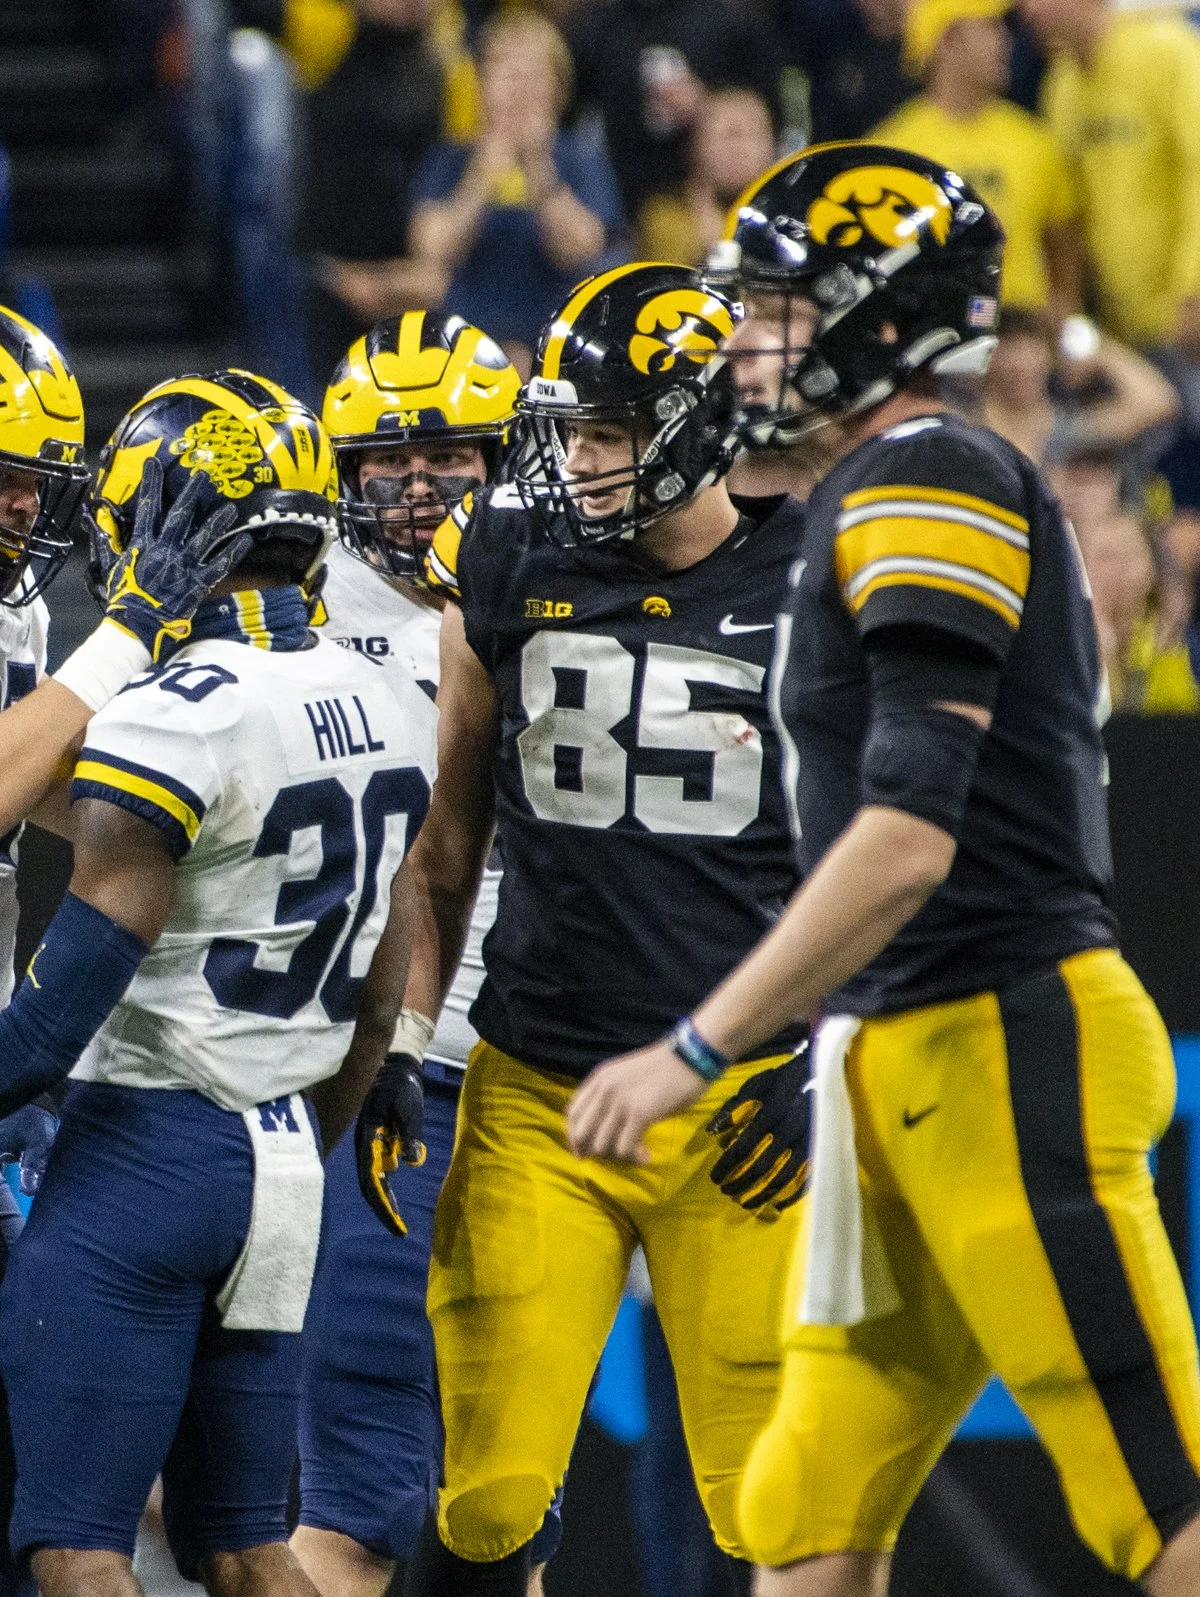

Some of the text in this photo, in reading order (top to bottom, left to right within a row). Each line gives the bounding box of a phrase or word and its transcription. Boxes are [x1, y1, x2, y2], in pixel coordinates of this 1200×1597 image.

[536, 383, 557, 397] IOWA
[398, 410, 421, 428] M
[61, 445, 77, 463] M
[253, 466, 273, 484] 30
[304, 695, 386, 761] HILL
[517, 630, 766, 837] 85
[202, 766, 432, 1024] 30
[255, 1093, 301, 1133] M
